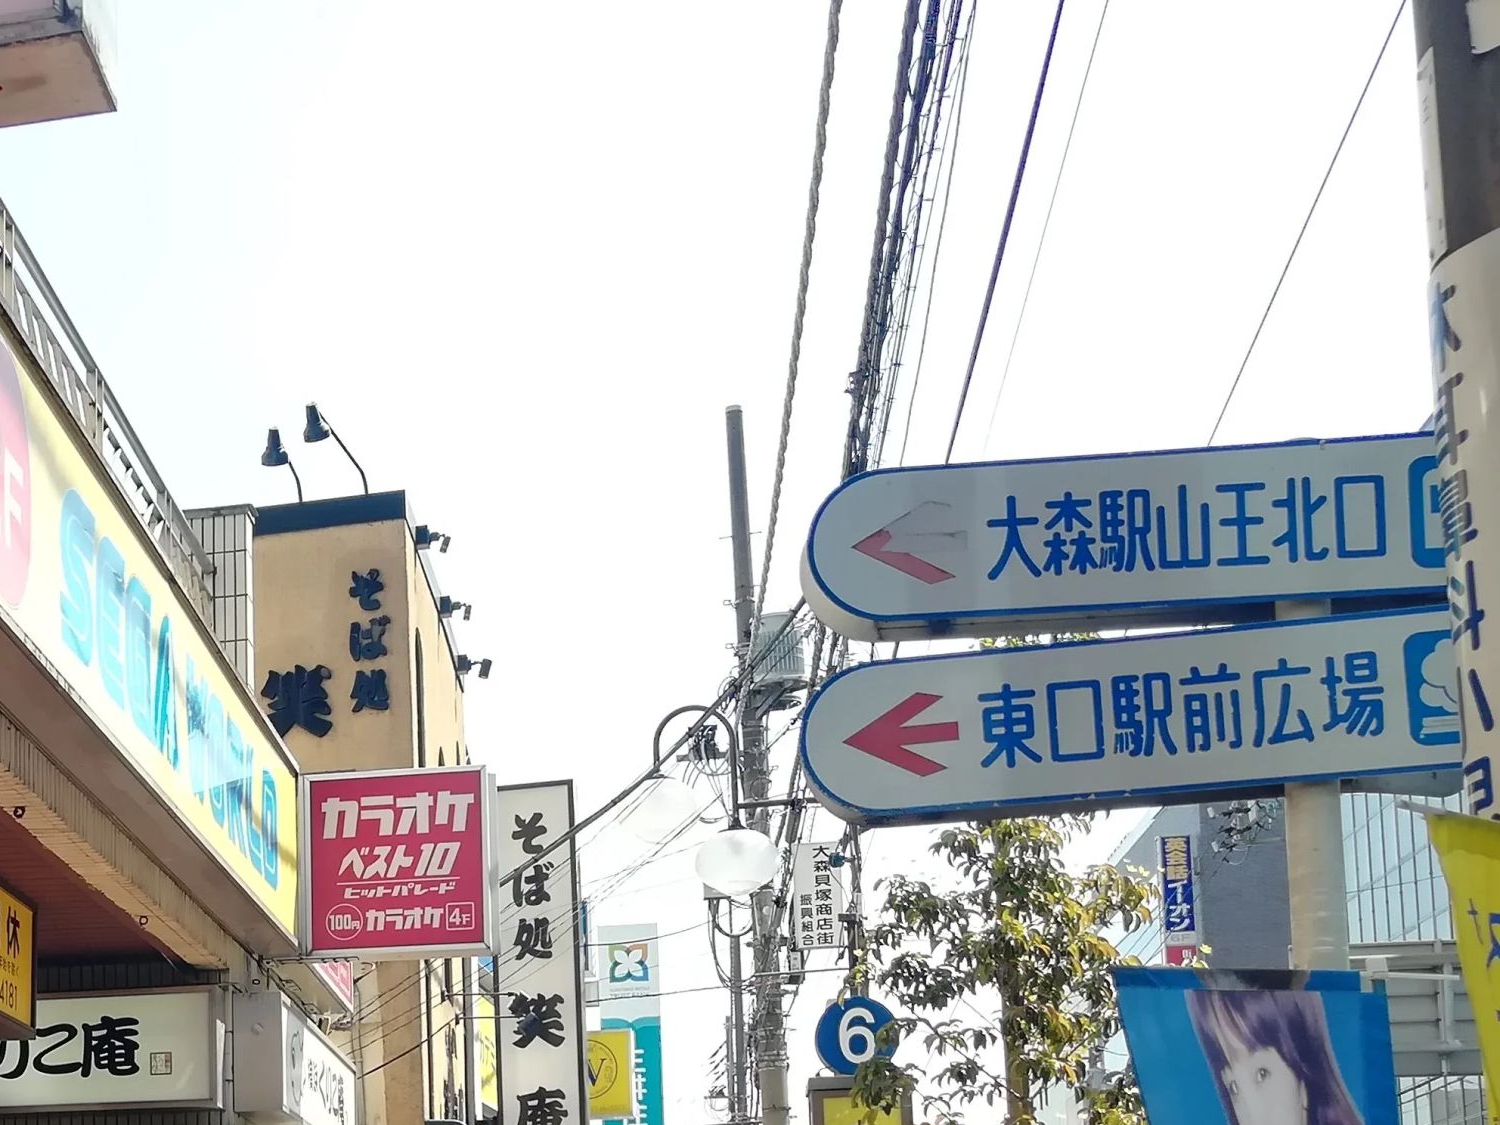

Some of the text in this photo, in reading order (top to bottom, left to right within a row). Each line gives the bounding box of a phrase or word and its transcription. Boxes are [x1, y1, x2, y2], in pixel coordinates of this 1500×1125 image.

[985, 474, 1388, 582] 大森駅山王北口
[348, 567, 389, 713] そば処
[59, 488, 280, 891] SEGA WORLD
[976, 649, 1387, 769] 東口駅前広場
[321, 790, 475, 839] カラオケ
[338, 842, 462, 881] ベスト10
[329, 906, 471, 932] 100円 カラオケ 4F
[343, 881, 457, 899] ヒットパレード
[510, 812, 555, 962] そば処
[799, 893, 816, 947] 振興組合
[811, 844, 834, 948] 大森貝塚商店街
[1164, 837, 1191, 932] 英会話イーオン
[838, 1007, 875, 1064] 6
